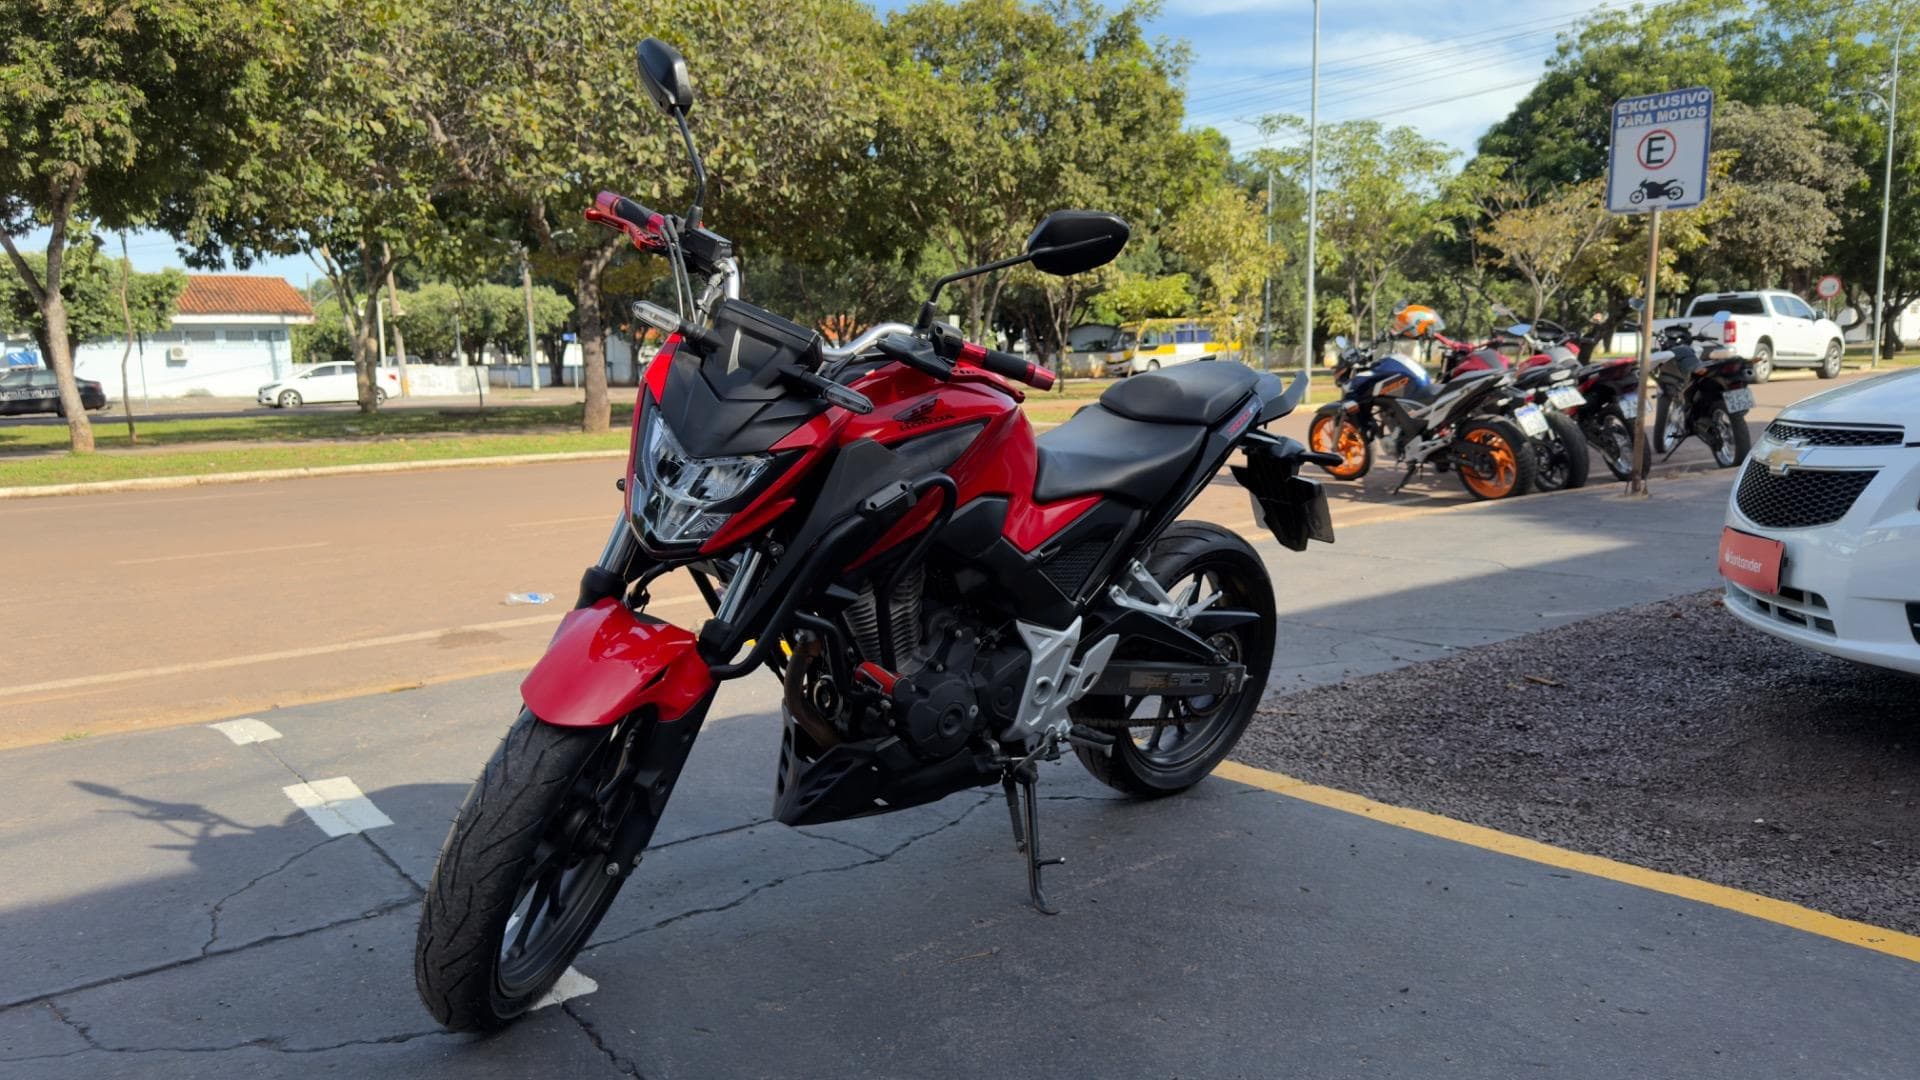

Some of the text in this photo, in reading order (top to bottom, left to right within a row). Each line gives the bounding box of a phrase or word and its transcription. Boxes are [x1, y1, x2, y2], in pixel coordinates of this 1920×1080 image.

[1618, 91, 1709, 114] EXCLUSIVO
[1617, 106, 1707, 128] PARA MOTOS
[1646, 136, 1666, 164] E
